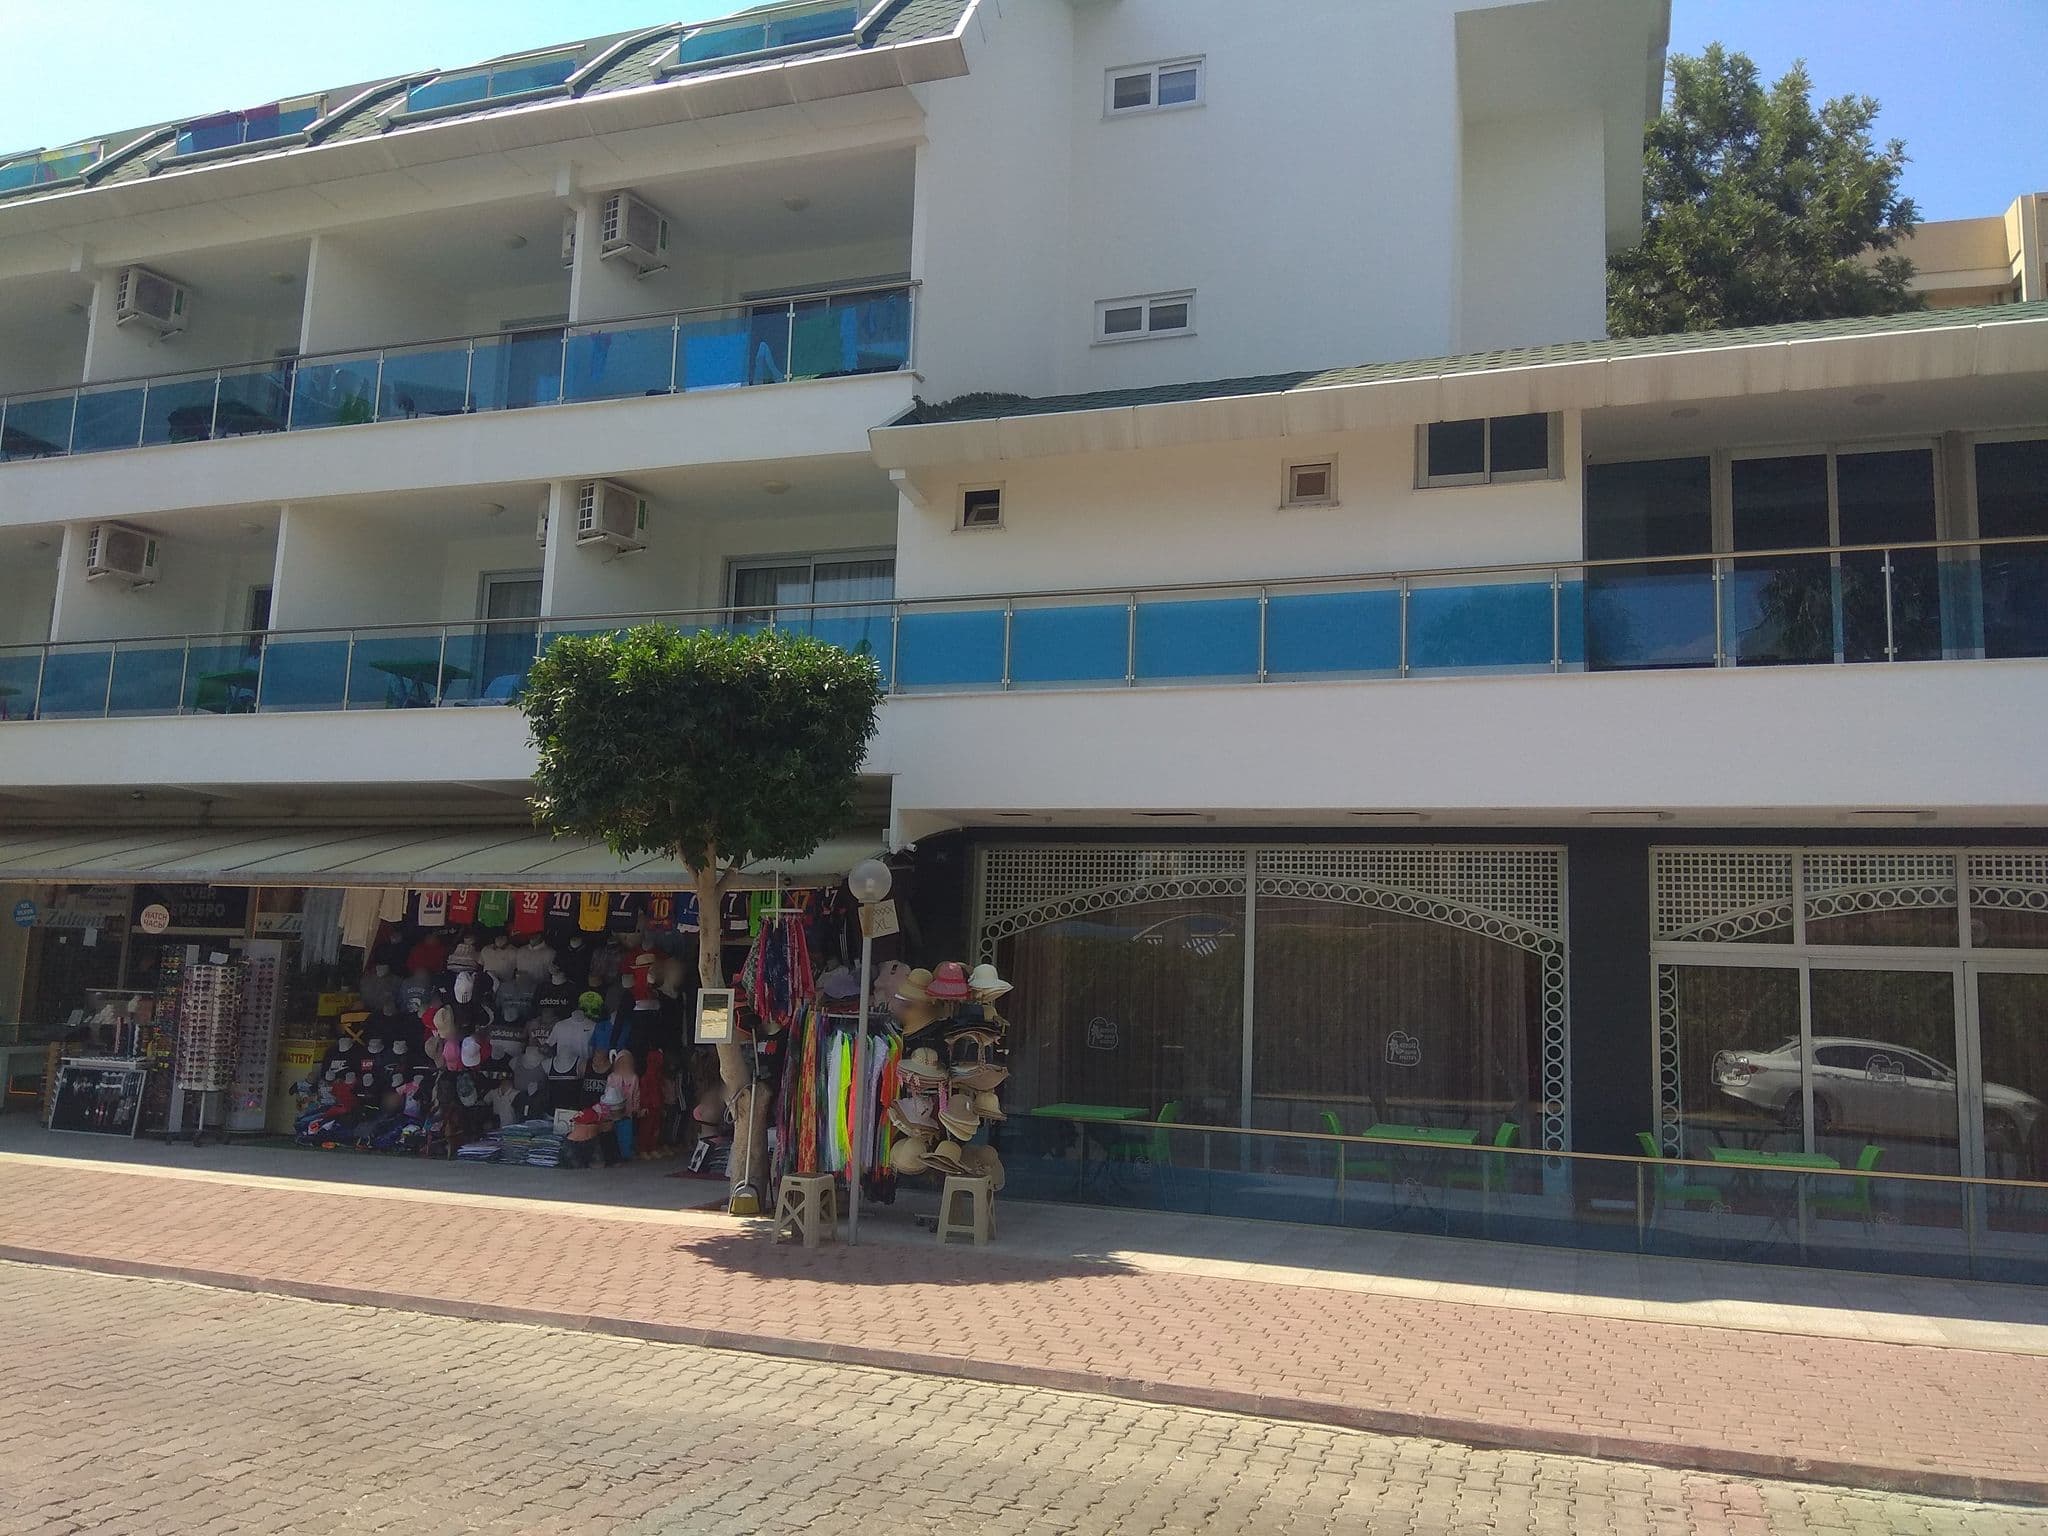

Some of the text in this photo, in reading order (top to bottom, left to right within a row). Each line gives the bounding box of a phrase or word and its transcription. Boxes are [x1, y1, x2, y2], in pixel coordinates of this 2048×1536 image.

[424, 891, 442, 909] 10
[522, 891, 540, 910] 32
[552, 892, 572, 910] 10
[619, 892, 631, 910] 7
[651, 898, 670, 918] 10
[728, 893, 738, 913] 7
[143, 918, 166, 928] ЧАСЫ
[144, 911, 168, 920] WATCH
